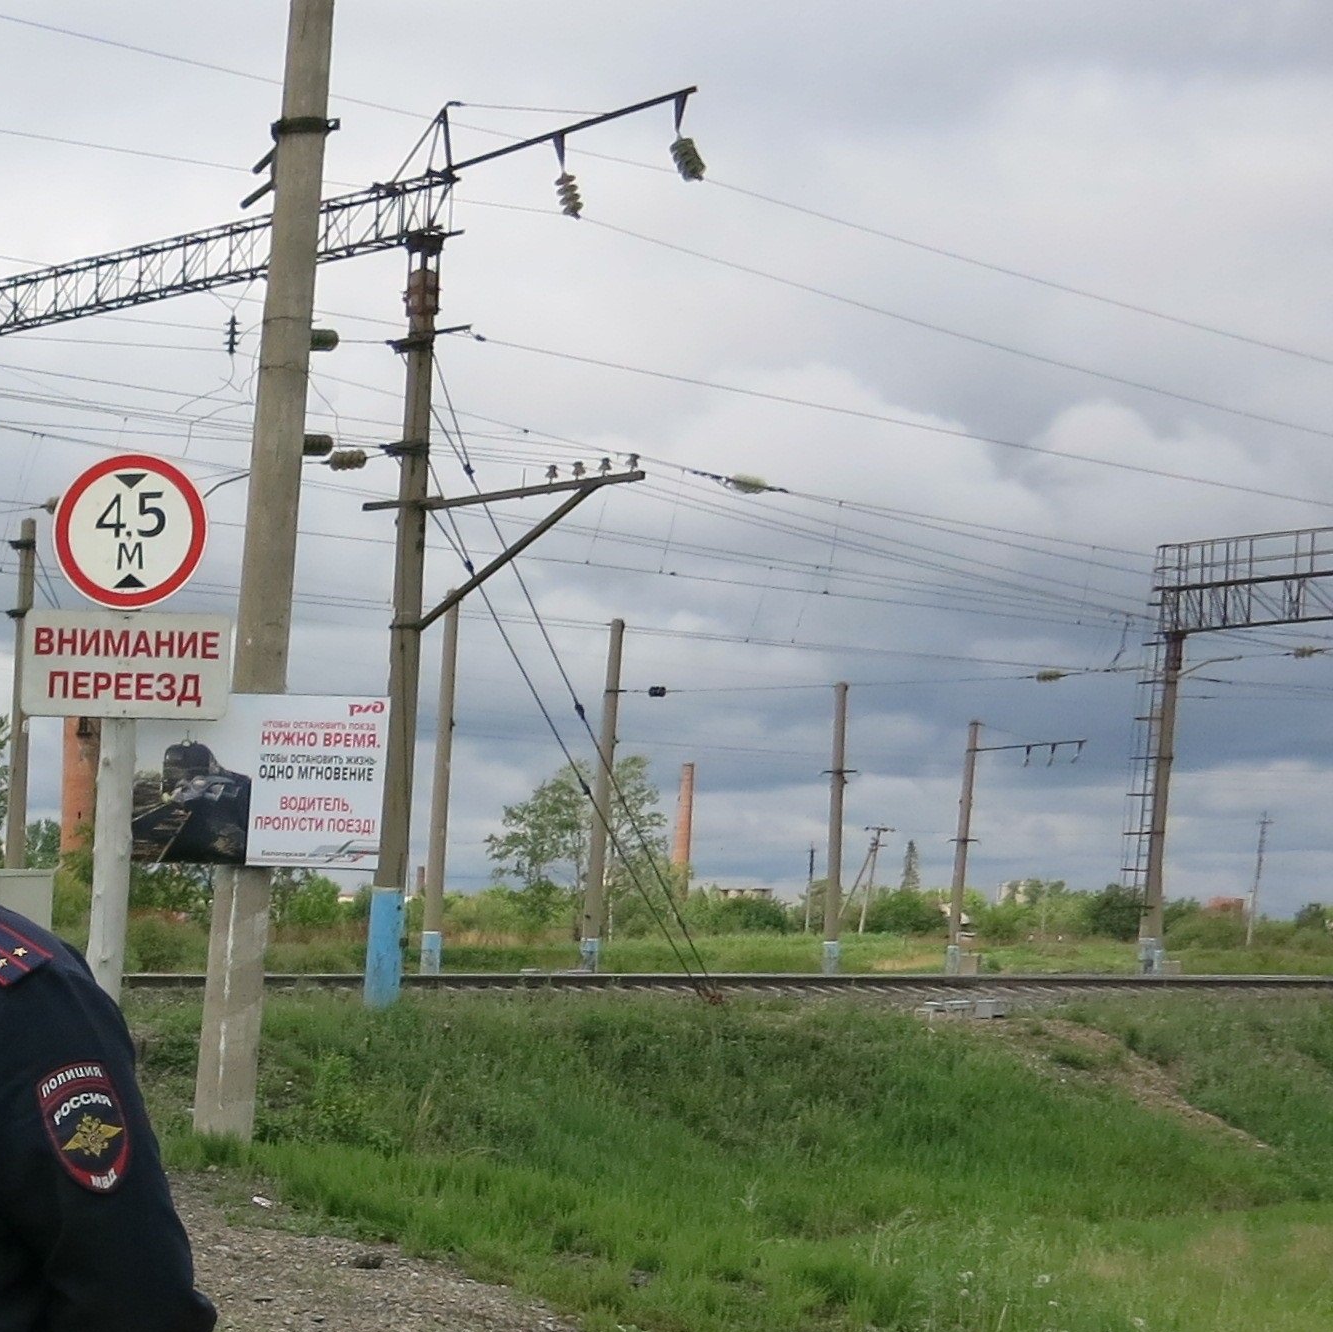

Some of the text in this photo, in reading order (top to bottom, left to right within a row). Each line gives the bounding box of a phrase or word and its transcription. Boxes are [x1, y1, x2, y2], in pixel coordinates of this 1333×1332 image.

[95, 491, 166, 540] 4,5
[116, 542, 144, 570] М
[34, 627, 220, 659] ВНИМАНИЕ
[48, 670, 202, 707] ПЕРЕЕЗД
[262, 720, 376, 731] ЧТОБЫ ОСТАНОВИТЬ ПОЕЗД
[261, 731, 381, 748] НУЖНО ВРЕМЯ.
[260, 753, 288, 763] ЧТОБЫ
[290, 754, 344, 765] ОСТАНОВИТЬ
[259, 764, 374, 781] ОДНО МГНОВЕНИЕ
[279, 796, 353, 813] ВОДИТЕЛЬ,
[254, 816, 376, 835] ПРОПУСТИ ПОЕЗД!
[41, 1066, 103, 1098] ПОЛИЦИЯ
[53, 1092, 112, 1126] РОССИЯ
[90, 1167, 118, 1189] МВД
